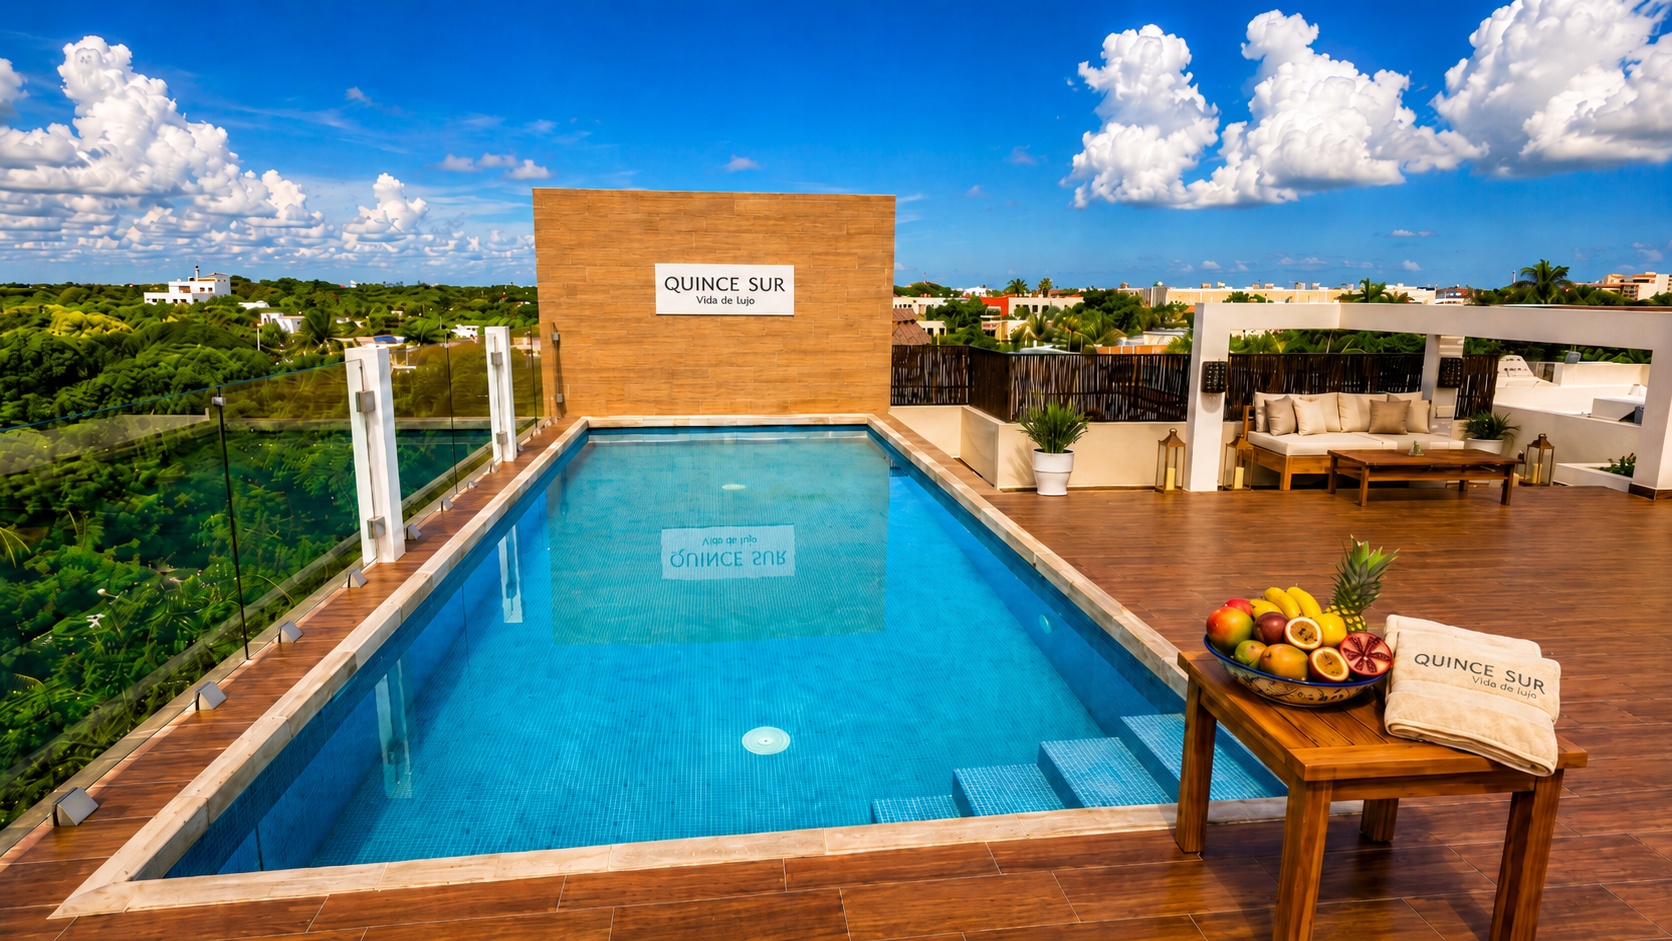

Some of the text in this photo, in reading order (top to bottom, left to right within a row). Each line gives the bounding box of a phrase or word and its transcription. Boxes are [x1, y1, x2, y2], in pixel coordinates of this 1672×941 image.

[664, 276, 786, 294] QUINCE SUR
[696, 295, 718, 304] Vida
[721, 295, 733, 305] de
[1414, 653, 1545, 695] QUINCE SUR
[1472, 675, 1497, 688] Vida
[1500, 683, 1514, 693] de
